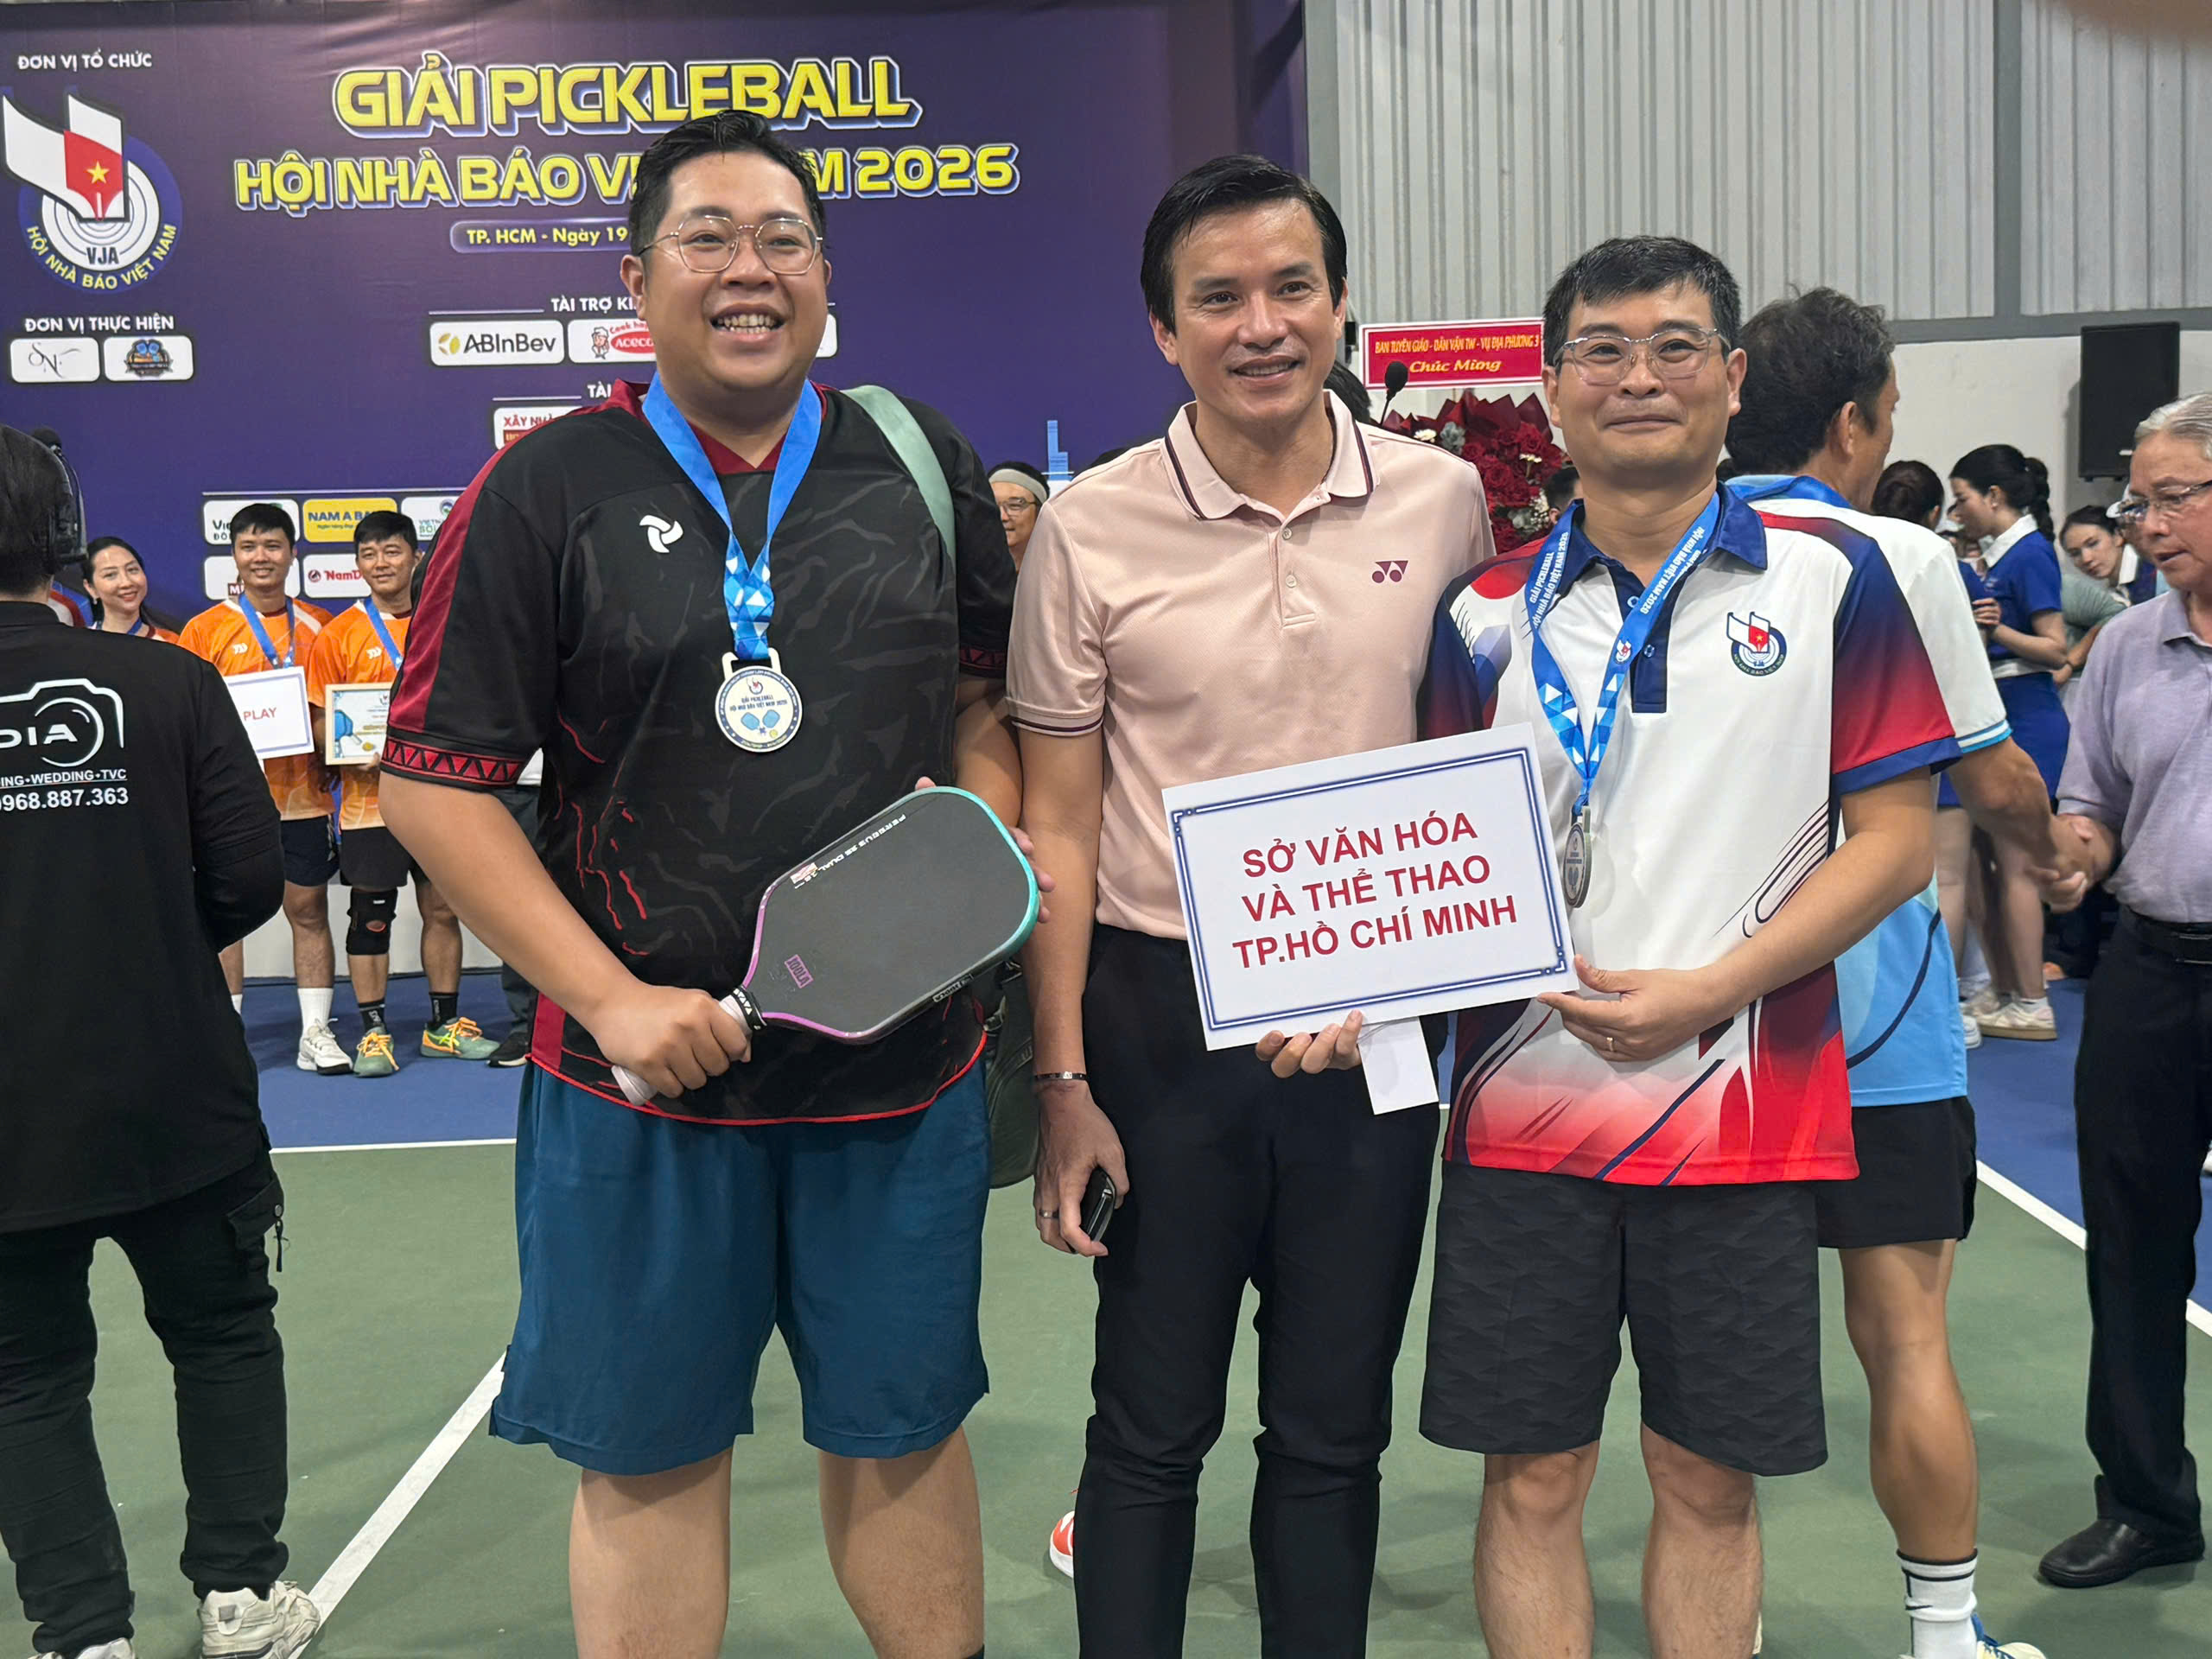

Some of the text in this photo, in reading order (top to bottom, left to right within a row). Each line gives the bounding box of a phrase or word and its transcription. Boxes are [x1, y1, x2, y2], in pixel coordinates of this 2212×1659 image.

[17, 48, 152, 72] ĐƠN VỊ TỔ CHỨC
[334, 52, 912, 130] GIẢI PICKLEBALL
[236, 151, 328, 212] HỘI
[335, 149, 453, 204] NHÀ
[460, 149, 582, 201] BÁO
[855, 145, 1014, 193] 2026
[467, 229, 491, 245] TP.
[496, 228, 537, 244] HCM
[552, 227, 601, 246] Ngày
[607, 226, 628, 242] 19
[27, 225, 177, 289] HỘI NHÀ BÁO VIỆT NAM
[86, 246, 119, 264] VJA
[550, 295, 575, 312] TÀI
[580, 297, 613, 314] TRỢ
[24, 312, 175, 334] ĐƠN VỊ THỰC HIỆN
[463, 334, 556, 353] ABInBev
[1376, 340, 1389, 353] BAN
[1409, 360, 1450, 373] Chúc
[588, 380, 612, 397] TÀI
[308, 512, 340, 522] NAM
[243, 707, 277, 721] PLAY
[0, 787, 129, 811] 968.887.363
[1242, 810, 1478, 878] SỞ VĂN HÓA
[1241, 855, 1491, 922] VÀ THỂ THAO
[1232, 894, 1517, 969] TP.HỒ CHÍ MINH
